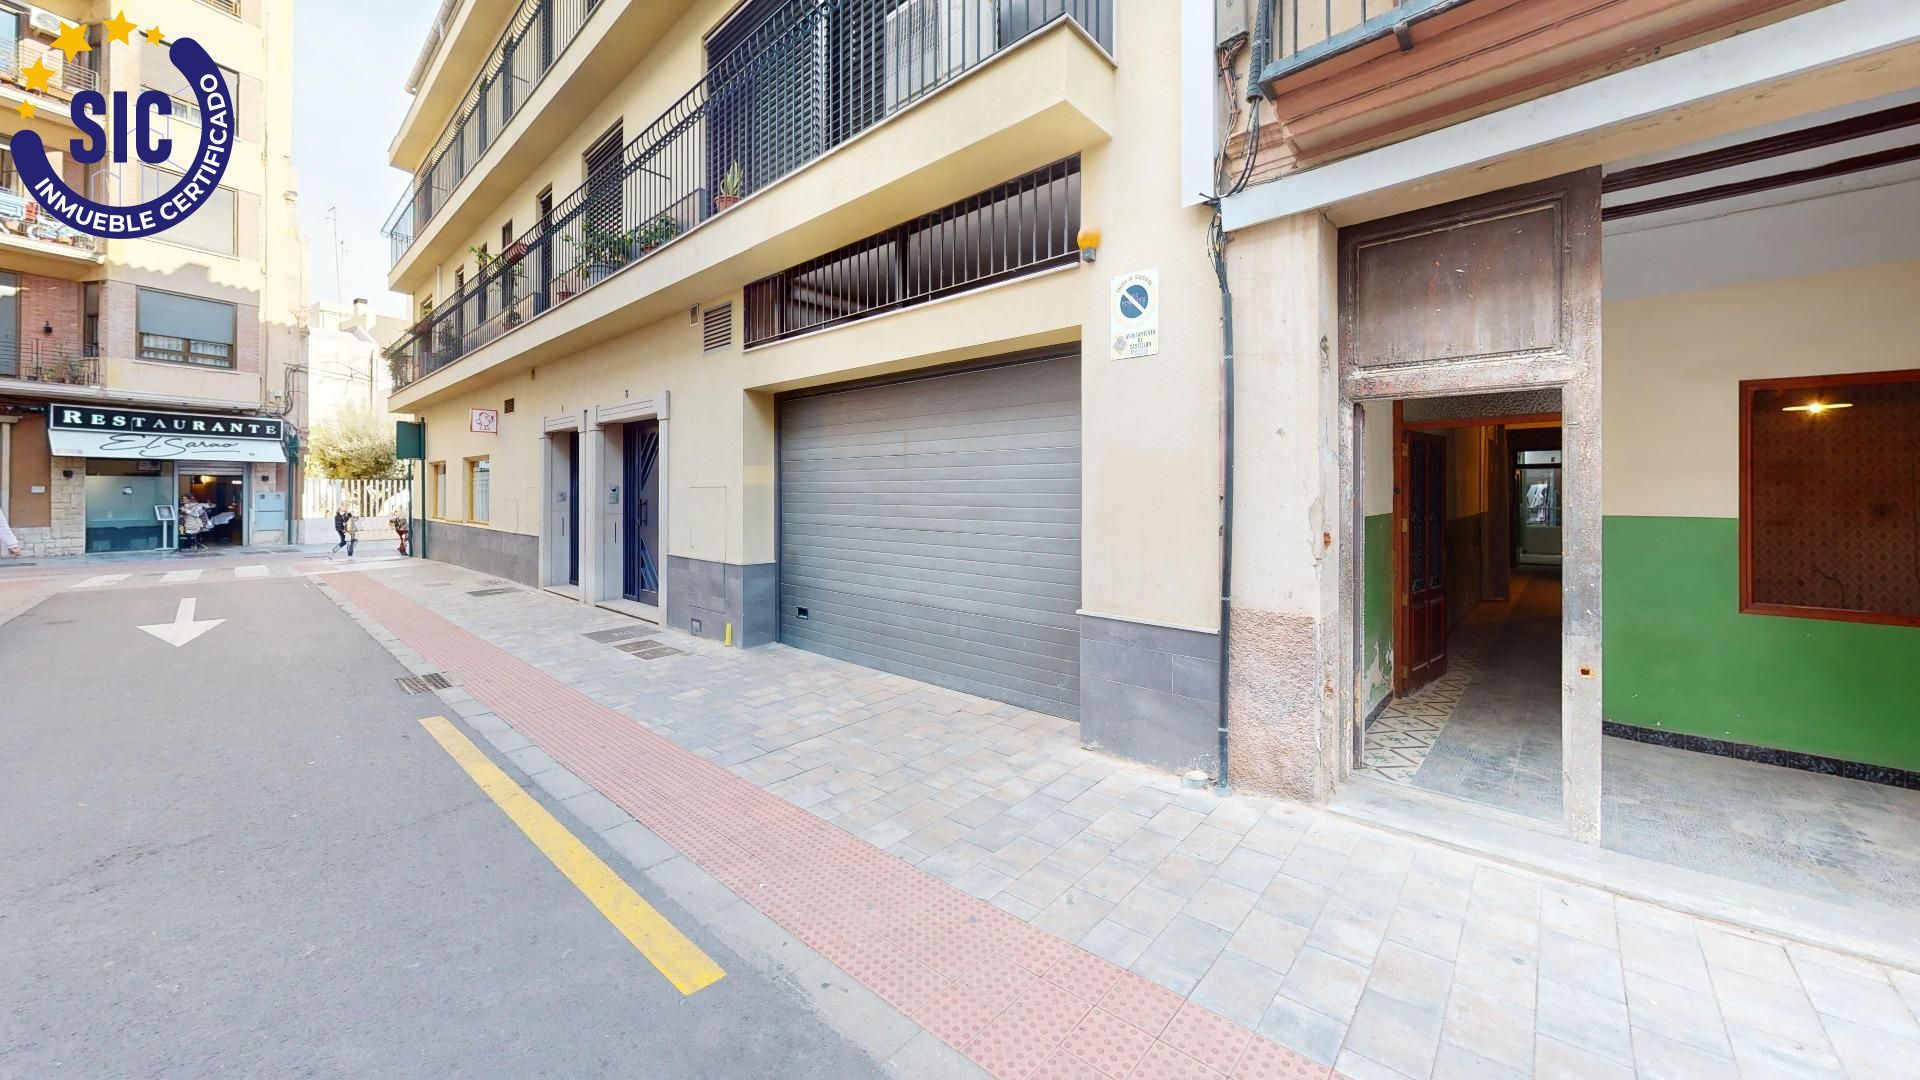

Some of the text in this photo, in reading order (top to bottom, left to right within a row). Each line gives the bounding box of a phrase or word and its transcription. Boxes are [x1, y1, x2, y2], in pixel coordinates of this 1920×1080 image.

[63, 409, 277, 435] RESTAURANTE
[99, 433, 239, 457] El Sarao
